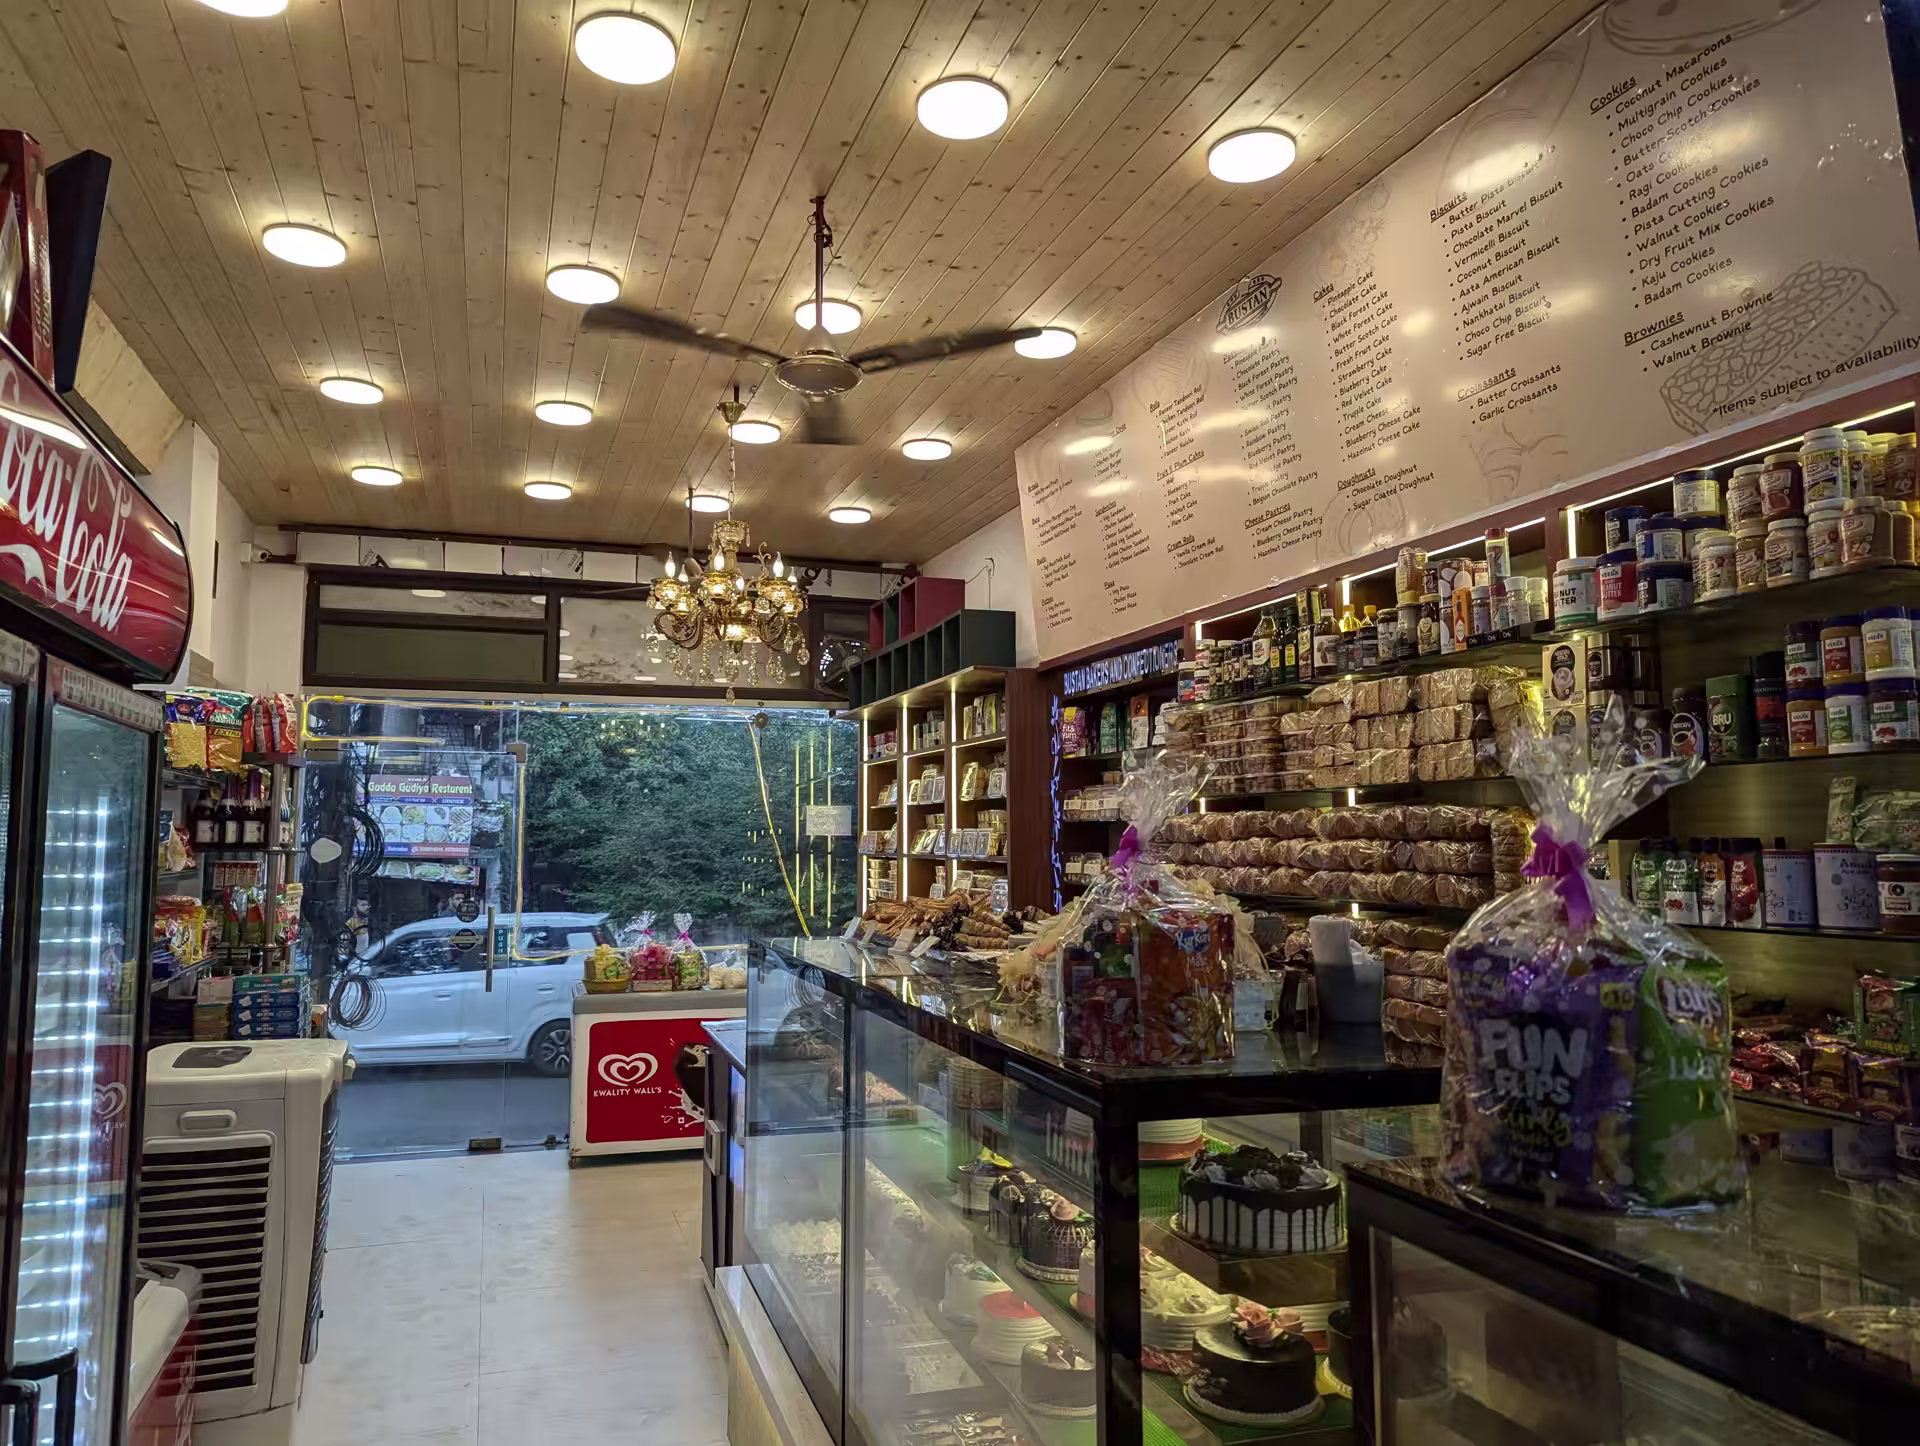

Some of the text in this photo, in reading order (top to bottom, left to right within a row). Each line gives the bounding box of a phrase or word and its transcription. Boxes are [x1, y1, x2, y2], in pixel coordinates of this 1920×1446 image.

[1615, 33, 1732, 114] Coconut Macaroons
[1589, 76, 1637, 112] Cookies
[1617, 57, 1728, 133] Multigrain Cookies
[1620, 73, 1734, 149] Choco Chip Cookies
[1666, 109, 1708, 142] Scotch
[1625, 162, 1655, 183] Oats
[1628, 160, 1690, 201] Ragi Cooki
[1631, 165, 1719, 219] Badam Cookies
[1429, 191, 1467, 221] Biscuits
[1448, 201, 1478, 225] Butter
[1480, 185, 1505, 205] Pista
[1634, 157, 1769, 236] Pista Cutting Cookies
[1451, 199, 1507, 240] Pista Biscuit
[1452, 181, 1563, 254] Chocolate Marvel Biscuit
[1636, 199, 1730, 252] Walnut Cookies
[1639, 196, 1774, 271] Dry Fruit Mix Cookies
[1454, 218, 1530, 269] Vermicelli Biscuit
[1456, 238, 1527, 284] Coconut Biscuit
[1459, 236, 1560, 299] Aata American Biscuit
[1641, 246, 1715, 289] Kaju Cookies
[1644, 258, 1733, 305] Badam Cookies
[1227, 286, 1268, 326] BUSTAN
[1313, 282, 1334, 301] Cakes
[1327, 270, 1374, 306] Pineapple Cake
[1329, 283, 1377, 319] Chocolate Cake
[1461, 274, 1523, 315] Ajwain Biscuit
[1462, 281, 1541, 329] Nankhatai Biscuit
[1330, 290, 1389, 332] Black Forest Cake
[1332, 302, 1393, 344] White Forest Cake
[1464, 294, 1549, 343] Choco Chip Biscuit
[1623, 311, 1684, 345] Brownies
[1650, 292, 1775, 351] Cashewnut Brownie
[1334, 314, 1398, 358] Butter Scotch Cake
[1336, 334, 1390, 371] Fresh Fruit Cake
[1466, 340, 1492, 358] Sugar
[1494, 329, 1515, 345] Free
[1652, 321, 1752, 369] Walnut Brownie
[1252, 366, 1270, 382] Forest
[1269, 355, 1290, 371] Pastry
[1337, 347, 1393, 384] Strawberry Cake
[1339, 365, 1387, 397] Blueberry Cake
[1760, 374, 1813, 401] subject
[1815, 368, 1831, 381] to
[1835, 336, 1920, 374] availability
[1341, 377, 1393, 409] Red Velvet Cake
[1365, 396, 1382, 410] Cake
[1477, 364, 1561, 408] Butter Croissants
[1479, 383, 1558, 422] Garlic Croissants
[1344, 409, 1389, 435] Cream Cheese
[1345, 406, 1421, 448] Blueberry Cheese Cake
[1347, 421, 1420, 461] Hazelnut Cheese Cake
[1337, 467, 1377, 490] Doughnuts
[1351, 463, 1418, 497] Chocolate Doughnut
[1352, 471, 1435, 511] Sugar Coated Doughnut
[0, 415, 134, 633] oca-Cola
[1244, 502, 1291, 528] Cheese Pastries
[1281, 537, 1301, 549] Cheese
[1301, 528, 1322, 542] Pastry
[1063, 670, 1086, 696] BUSTAN
[1086, 660, 1109, 690] BAKERS
[1109, 655, 1122, 685] AND
[1062, 732, 1077, 740] yum
[1712, 712, 1732, 726] BRU
[368, 781, 473, 795] Guddu Gudiya Resturent
[593, 1086, 662, 1098] KWALITY WALL'S
